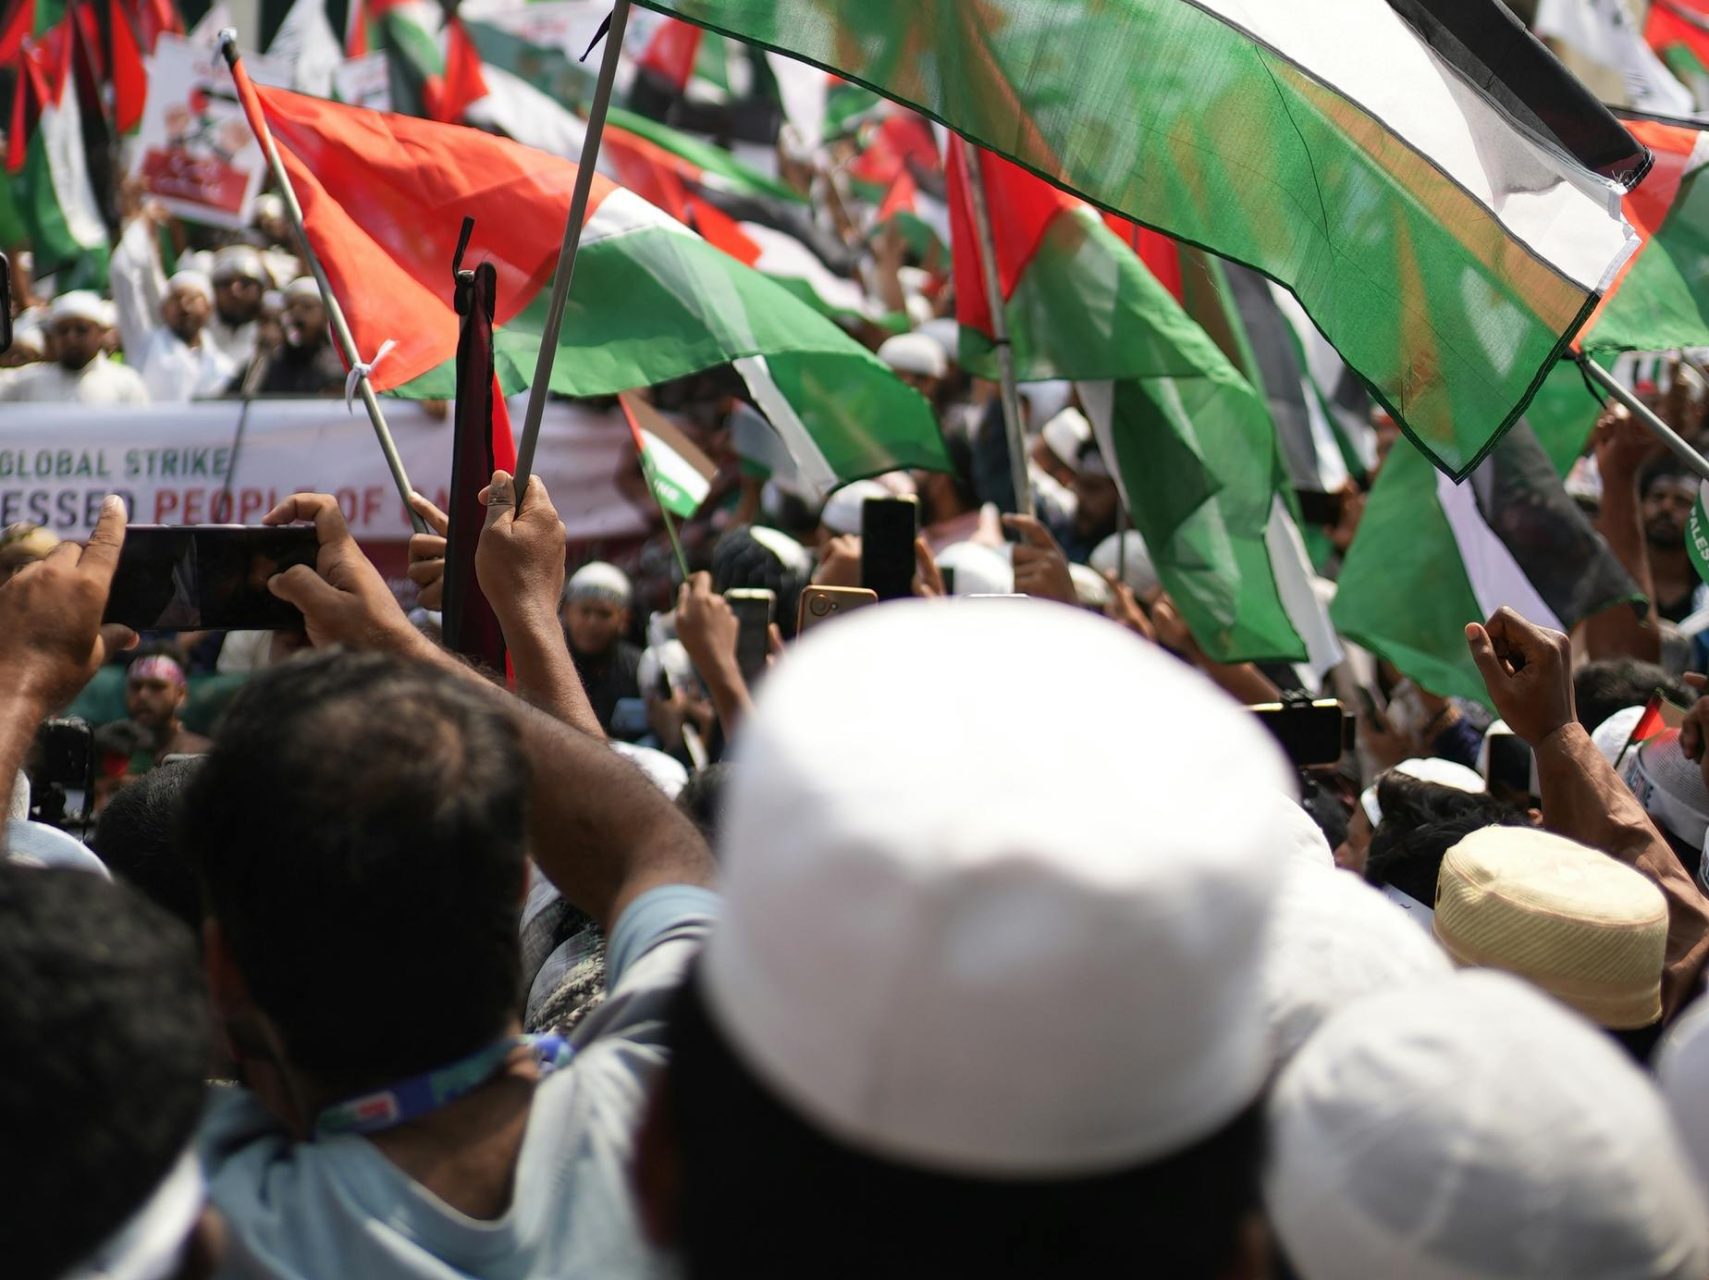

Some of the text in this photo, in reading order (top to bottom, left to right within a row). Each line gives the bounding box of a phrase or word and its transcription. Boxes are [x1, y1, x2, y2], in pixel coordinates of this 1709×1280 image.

[0, 446, 230, 478] GLOBAL STRIKE
[336, 485, 384, 526] OF
